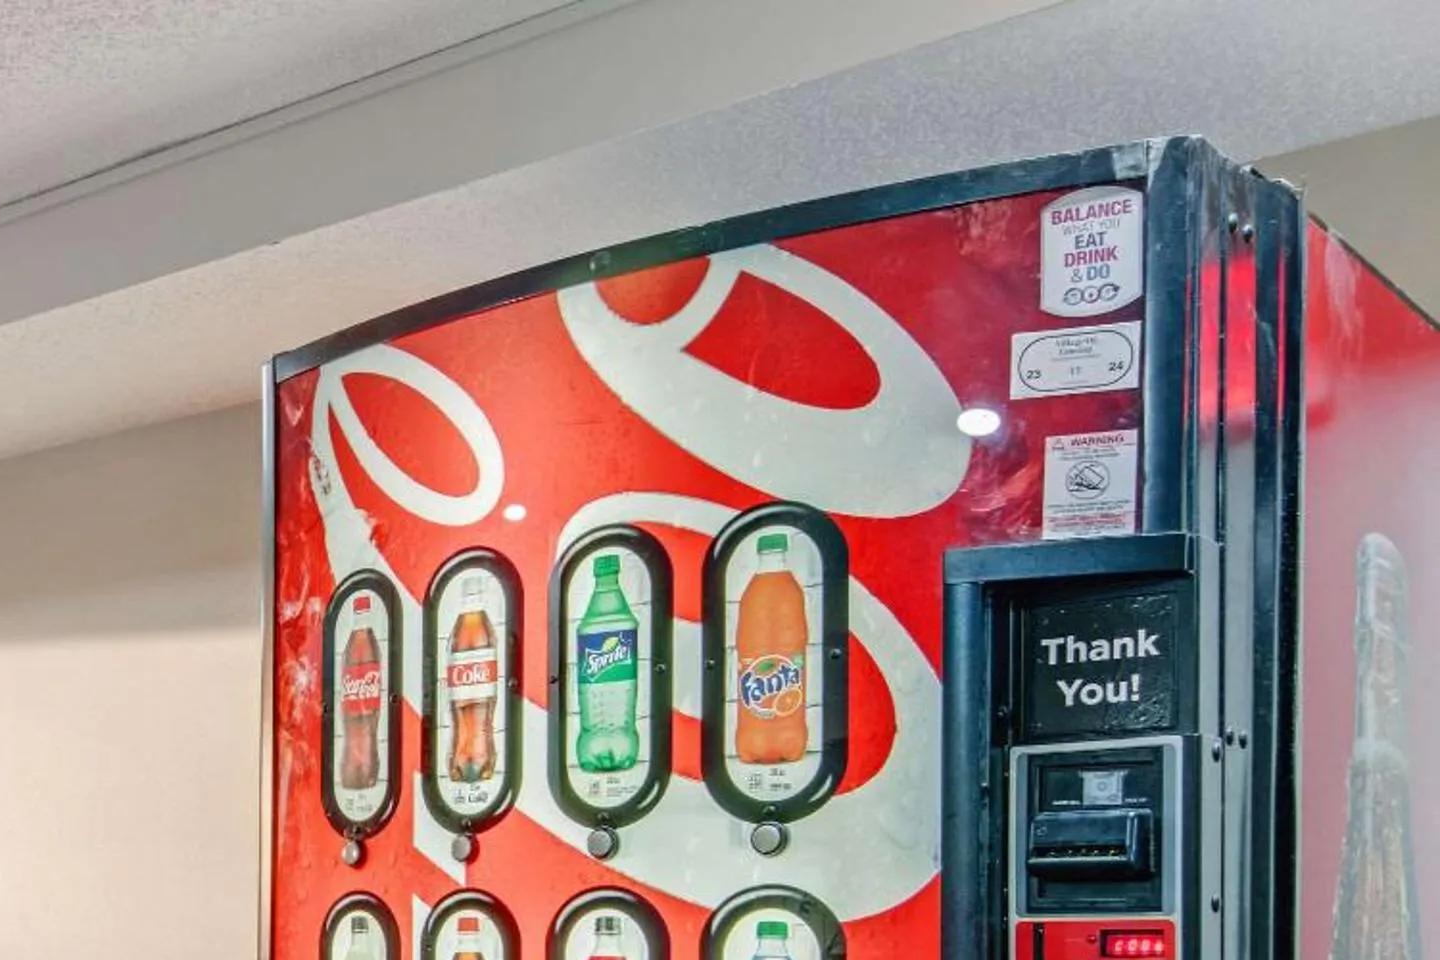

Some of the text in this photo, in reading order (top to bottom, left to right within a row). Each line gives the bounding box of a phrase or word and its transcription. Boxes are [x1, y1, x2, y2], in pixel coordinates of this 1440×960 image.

[1051, 199, 1132, 225] BALANCE
[1074, 231, 1107, 250] EAT
[1064, 245, 1118, 268] DRINK
[1071, 263, 1110, 283] & DO
[1026, 370, 1041, 379] 23
[1071, 434, 1124, 447] WARNING
[1040, 629, 1162, 666] Thank
[586, 645, 629, 674] Sprite
[452, 666, 491, 684] Coke
[740, 666, 800, 707] Fanta
[1056, 673, 1142, 707] You!
